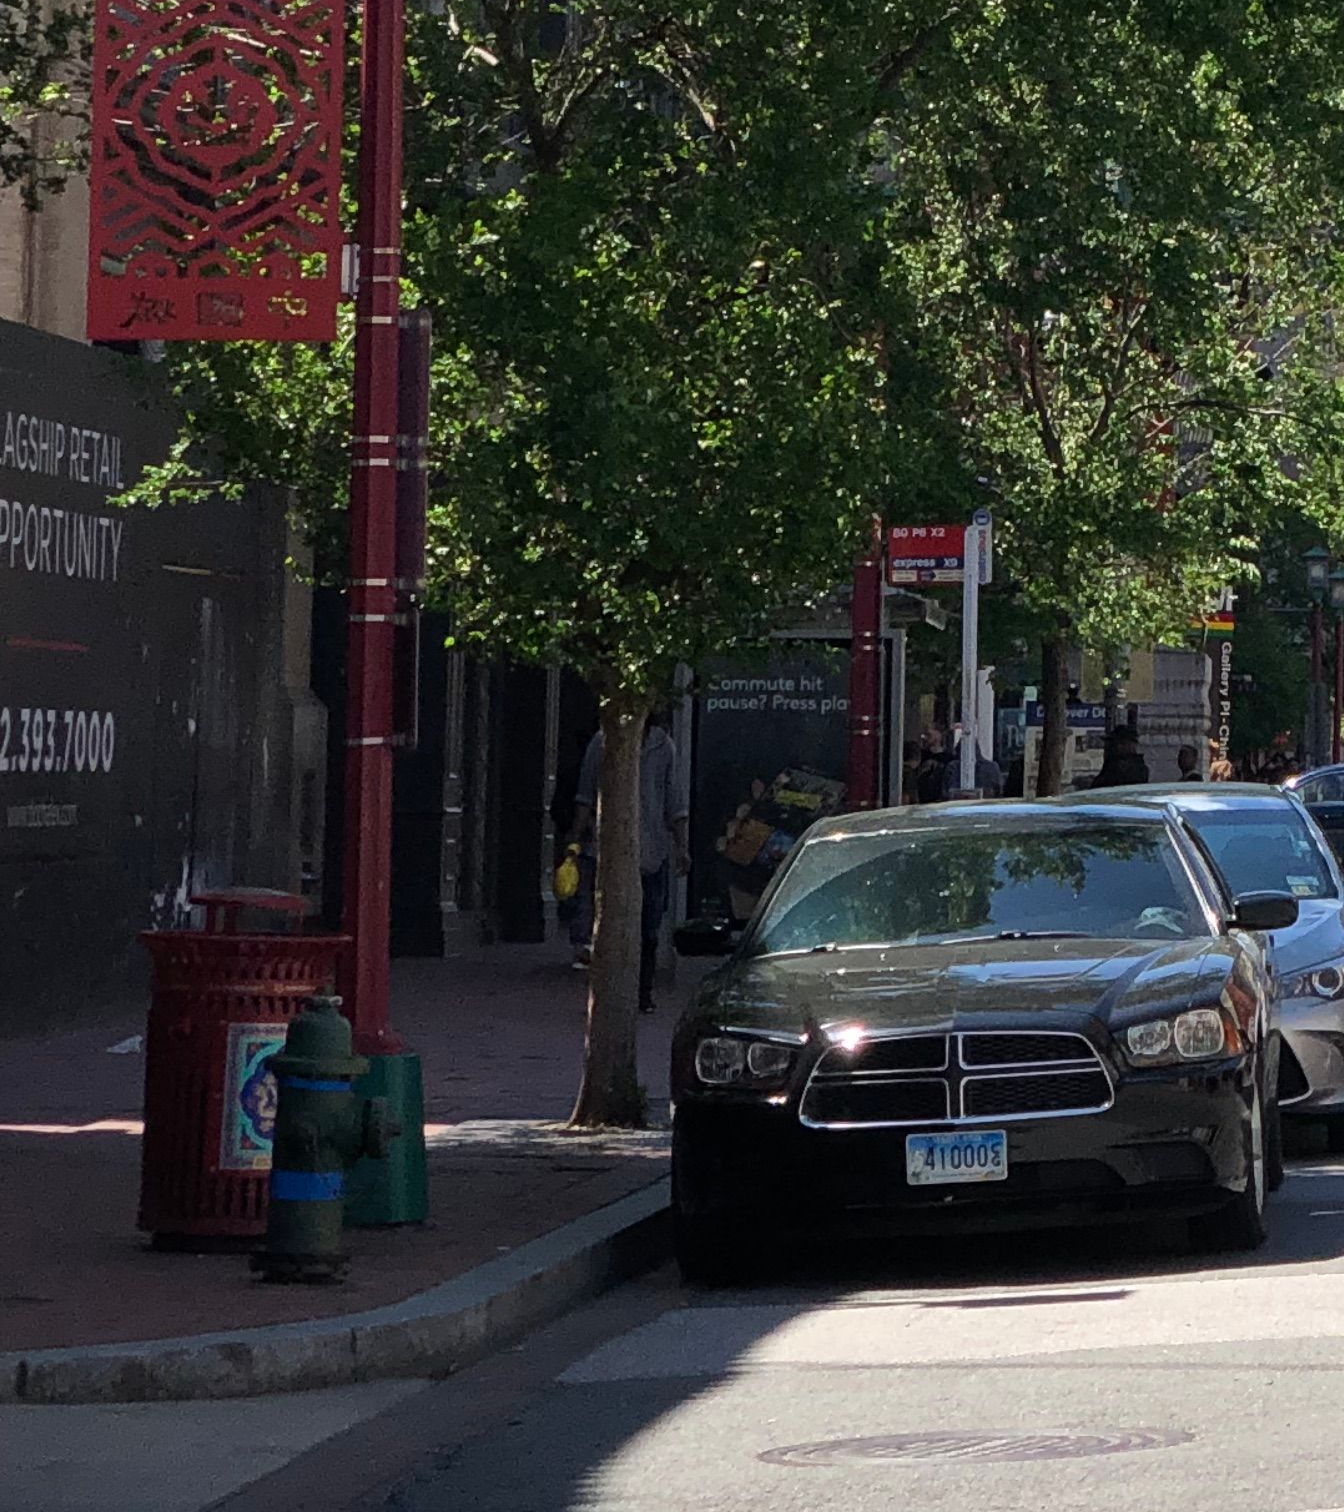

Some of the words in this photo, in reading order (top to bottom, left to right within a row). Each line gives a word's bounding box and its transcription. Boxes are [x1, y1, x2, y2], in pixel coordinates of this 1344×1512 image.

[0, 411, 65, 477] AGSHIP
[69, 425, 125, 489] RETAIL
[930, 527, 946, 538] X2
[800, 675, 823, 691] hit
[1218, 641, 1232, 697] Gallery
[706, 694, 768, 713] pause?
[772, 694, 817, 710] Press
[820, 695, 850, 715] pla
[1218, 700, 1231, 761] Pl-Chin
